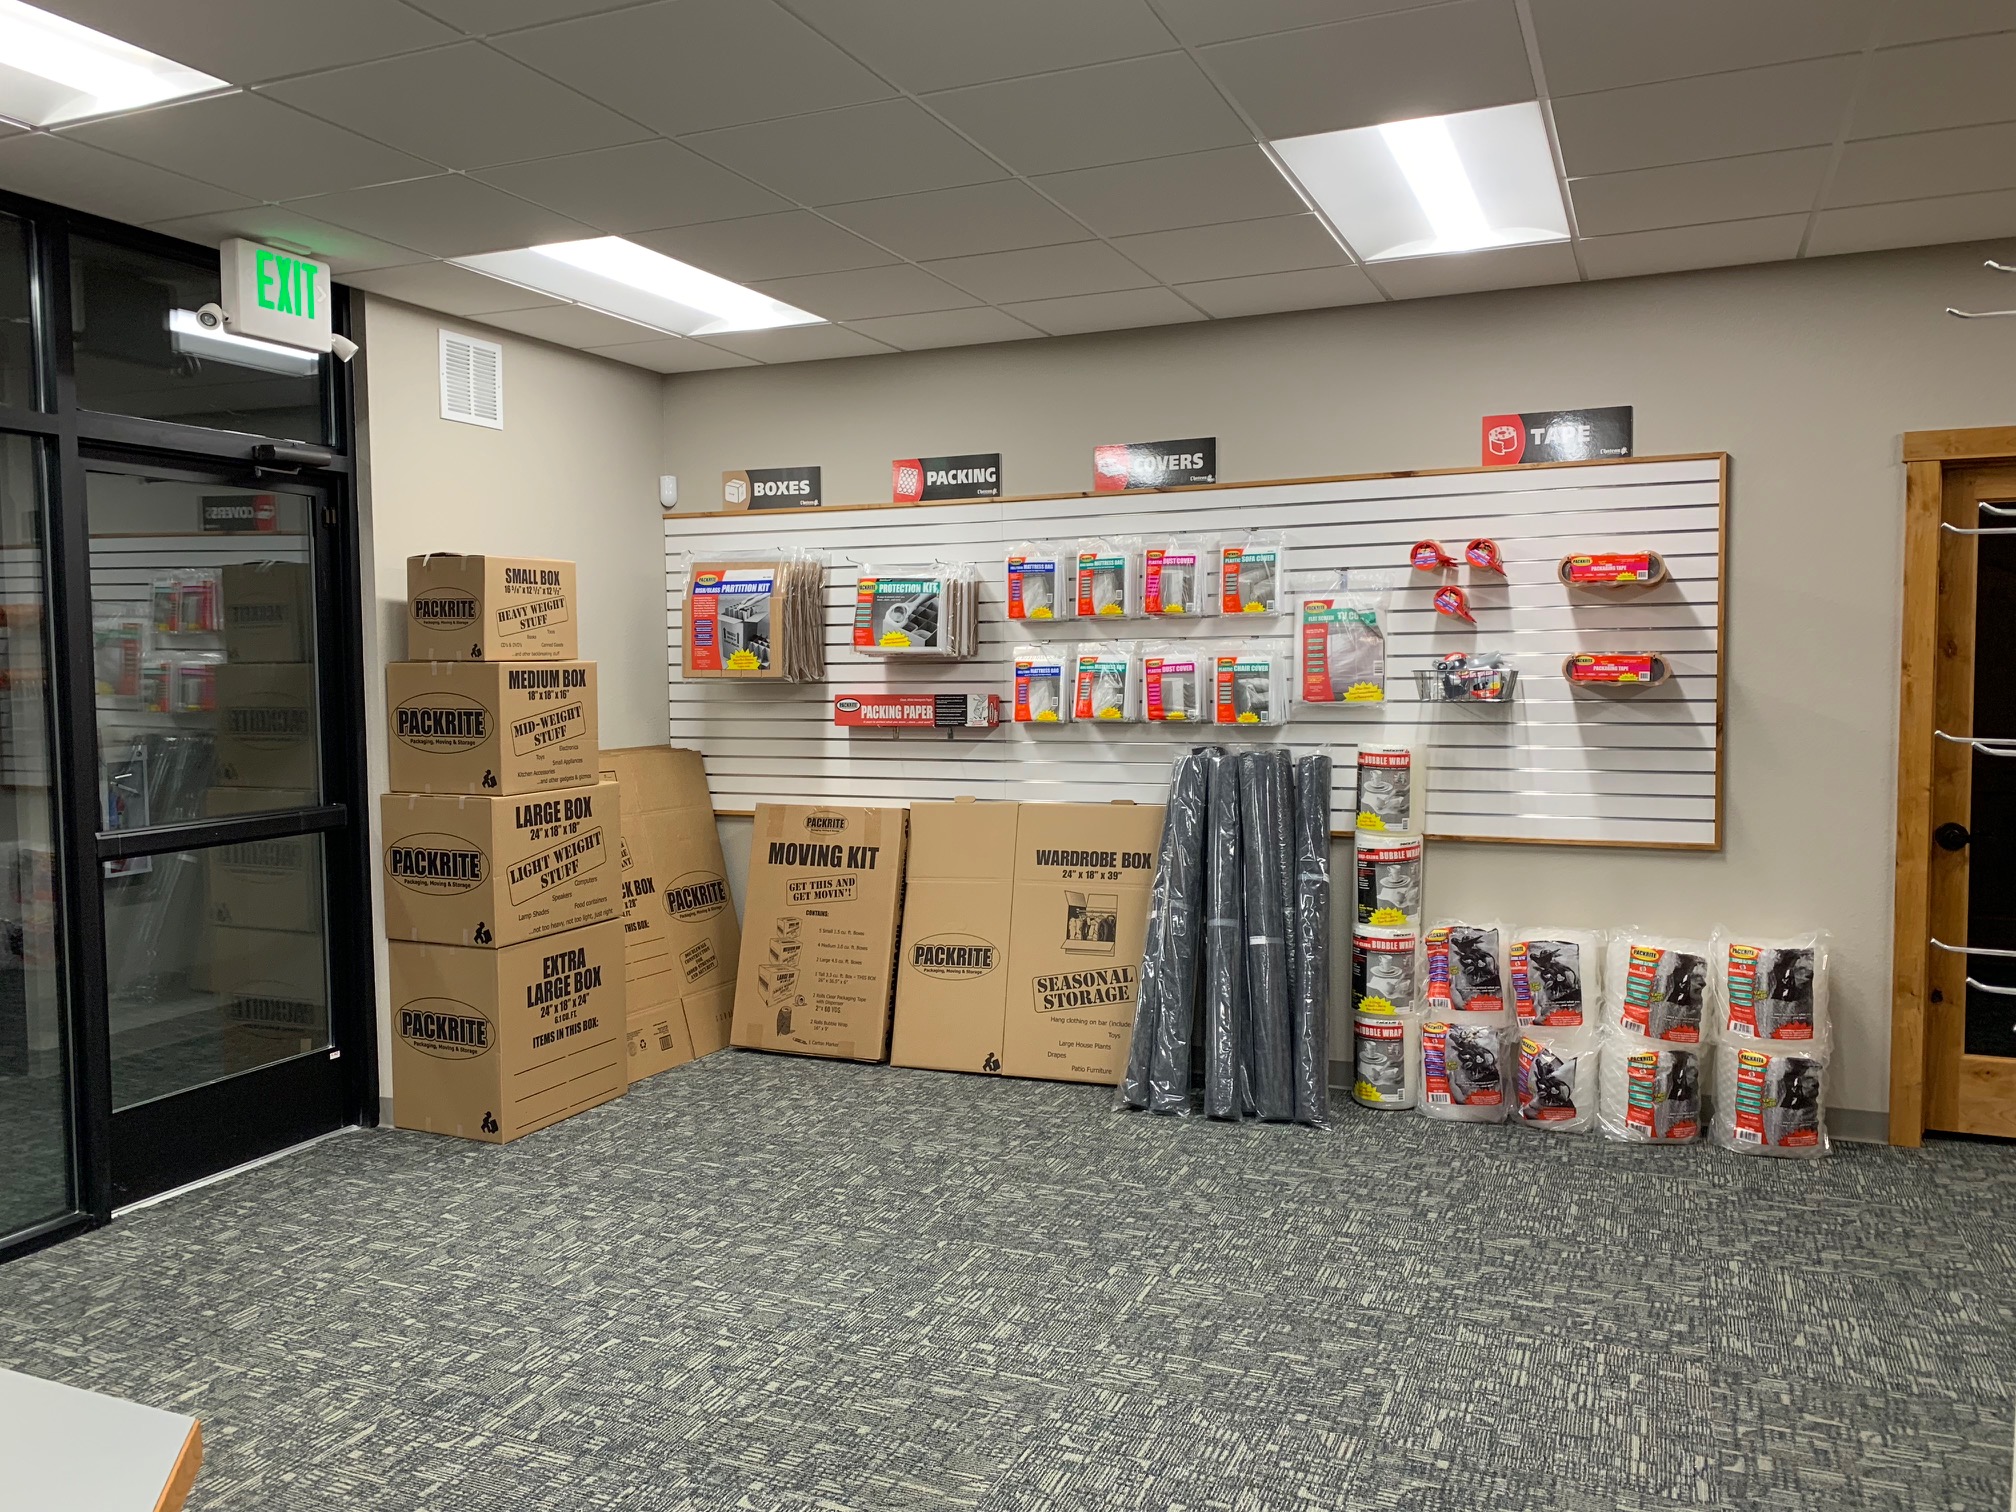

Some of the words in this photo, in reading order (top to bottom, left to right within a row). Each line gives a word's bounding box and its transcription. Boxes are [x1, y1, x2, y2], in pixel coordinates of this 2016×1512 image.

[255, 249, 319, 320] EXIT
[1530, 425, 1591, 445] TAPE
[1133, 452, 1204, 473] COVERS
[926, 467, 997, 486] PACKING
[754, 480, 810, 496] BOXES
[1162, 557, 1176, 565] DUST
[1176, 557, 1194, 565] COVER
[1256, 554, 1275, 562] COVER
[505, 567, 538, 585] SMALL
[540, 570, 560, 586] BOX
[721, 583, 757, 593] PARTITION
[757, 583, 771, 592] KIT
[878, 583, 922, 593] PROTECTION
[922, 582, 939, 593] KIT
[415, 600, 475, 619] PACKRITE
[498, 606, 528, 623] HEAVY
[530, 598, 565, 614] WEIGHT
[520, 614, 548, 630] STUFF
[1162, 665, 1176, 673] DUST
[1250, 664, 1269, 672] COVER
[509, 670, 560, 690] MEDIUM
[562, 669, 587, 688] BOX
[528, 690, 539, 701] 18"
[544, 690, 554, 700] 18"
[560, 689, 570, 700] 16"
[861, 705, 901, 719] PACKING
[903, 705, 934, 719] PAPER
[398, 709, 485, 737] PACKRITE
[513, 706, 582, 738] MID-WEIGHT
[534, 725, 567, 747] STUFF
[1364, 755, 1388, 765] BUBBLE
[1389, 756, 1410, 765] WRAP
[559, 775, 575, 783] gadgets
[515, 800, 562, 829] LARGE
[564, 796, 593, 821] BOX
[806, 817, 845, 829] PACKRITE
[530, 827, 543, 841] 24"
[550, 825, 562, 837] 18"
[569, 821, 581, 834] 18"
[510, 854, 551, 885] LIGHT
[554, 831, 601, 864] WEIGHT
[768, 842, 843, 868] MOVING
[847, 846, 880, 870] KIT
[1036, 849, 1117, 868] WARDROBE
[1121, 852, 1152, 870] BOX
[1379, 851, 1405, 860] BUBBLE
[391, 849, 481, 880] PACKRITE
[540, 859, 579, 889] STUFF
[574, 876, 598, 887] Computers
[1062, 869, 1077, 880] 24"
[1085, 870, 1099, 880] 18"
[1107, 870, 1123, 880] 39"
[404, 878, 429, 887] Packaging,
[429, 880, 447, 888] Moving
[452, 881, 472, 889] Storage
[633, 877, 656, 896] BOX
[789, 881, 808, 892] GET
[809, 879, 833, 890] THIS
[835, 877, 855, 888] AND
[552, 891, 573, 902] Speakers
[574, 900, 586, 909] Food
[586, 896, 608, 906] containers
[666, 881, 726, 913] PACKRITE
[793, 891, 812, 902] GET
[814, 888, 852, 900] MOVIN'!
[518, 911, 533, 922] Lamp
[532, 908, 550, 918] Shades
[541, 923, 550, 932] too
[566, 918, 574, 926] not
[574, 915, 582, 923] too
[594, 910, 603, 919] just
[603, 907, 614, 917] right
[805, 909, 830, 918] CONTAINS:
[1371, 940, 1398, 950] BUBBLE
[1399, 941, 1415, 950] WRAP
[914, 946, 993, 968] PACKRITE
[1633, 950, 1657, 959] PACKRITE
[542, 947, 587, 979] EXTRA
[527, 974, 571, 1009] LARGE
[574, 965, 602, 994] BOX
[1037, 968, 1134, 994] SEASONAL
[836, 995, 857, 1003] Packaging
[1043, 985, 1130, 1010] STORAGE
[540, 1004, 553, 1019] 24"
[560, 999, 571, 1012] 18"
[578, 993, 590, 1006] 24"
[401, 1011, 487, 1046] PACKRITE
[1050, 1016, 1065, 1024] Hang
[1066, 1017, 1088, 1026] clothing
[532, 1031, 555, 1049] ITEMS
[556, 1028, 564, 1041] IN
[565, 1023, 582, 1038] THIS
[582, 1016, 599, 1032] BOX:
[1108, 1031, 1121, 1039] Toys
[1382, 1029, 1403, 1037] WRAP
[438, 1044, 455, 1052] Moving
[460, 1046, 478, 1055] Storage
[1058, 1040, 1075, 1048] Large
[1075, 1041, 1093, 1049] House
[1094, 1042, 1112, 1050] Plants
[1047, 1051, 1067, 1059] Drapes
[1741, 1054, 1765, 1063] PACKRITE
[1086, 1066, 1113, 1075] Furniture
